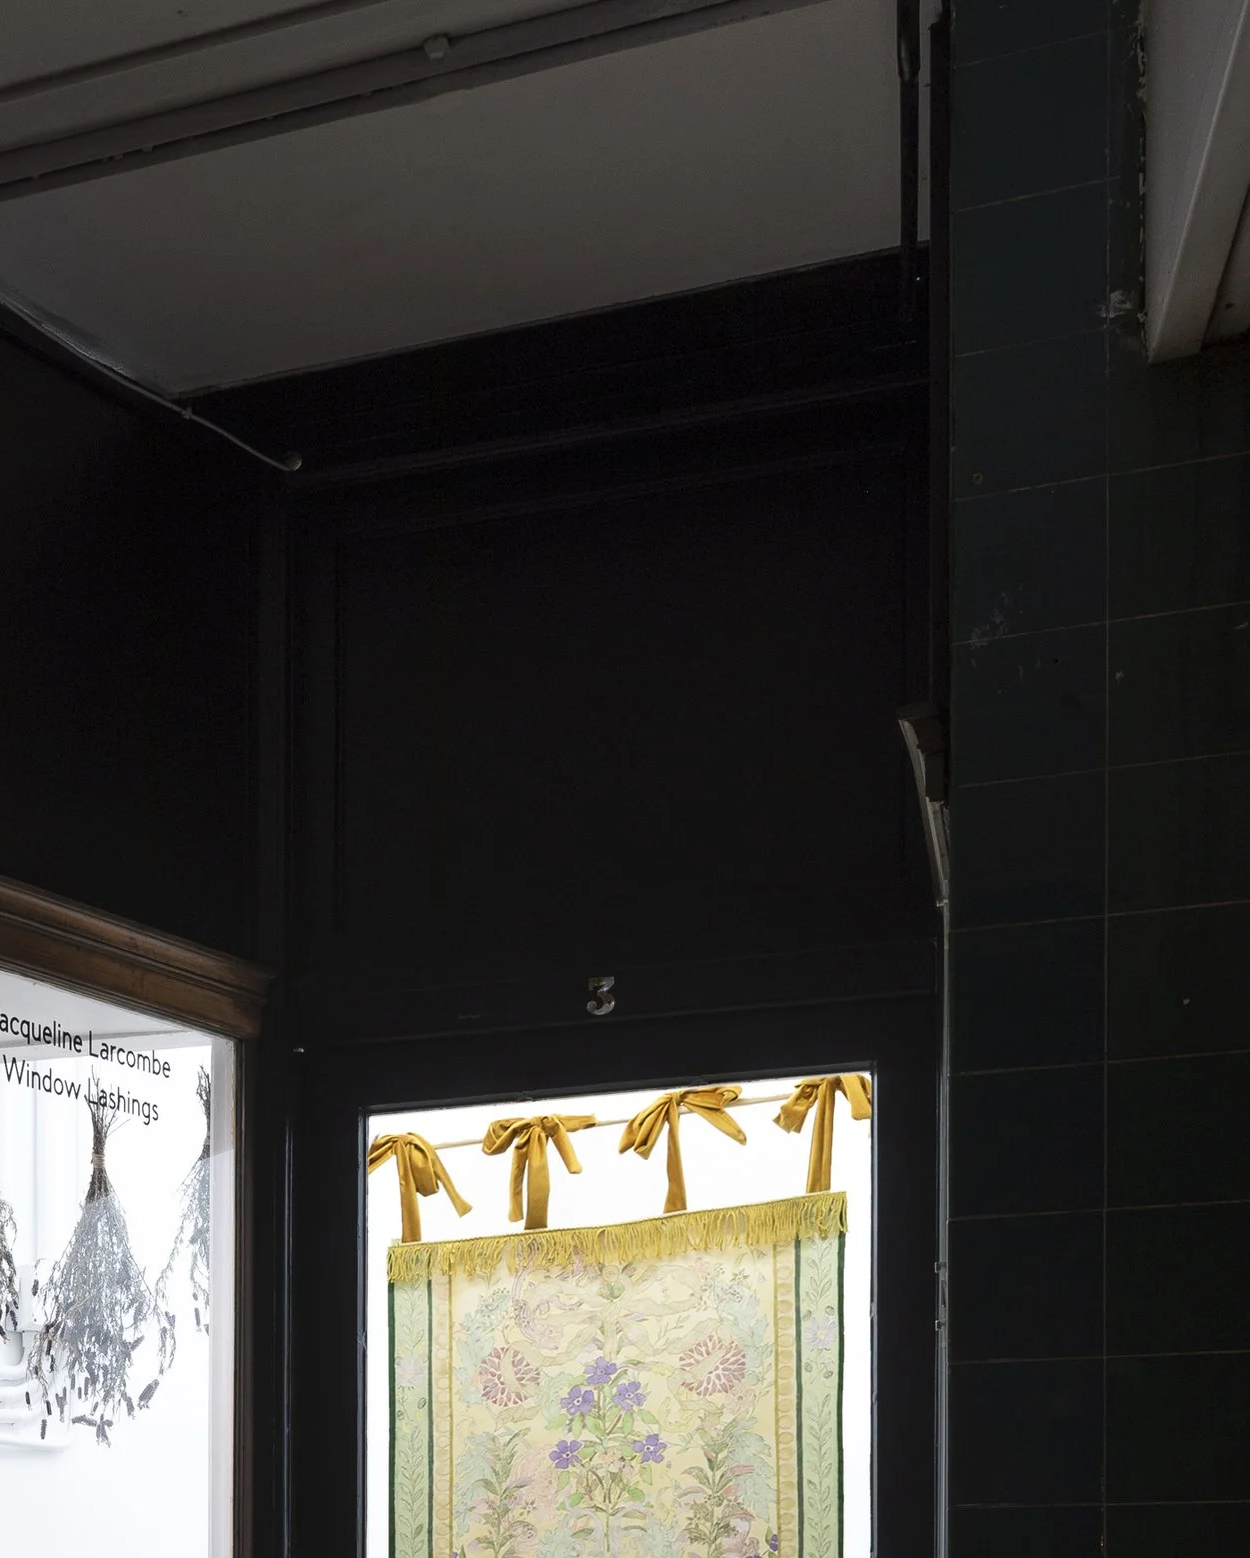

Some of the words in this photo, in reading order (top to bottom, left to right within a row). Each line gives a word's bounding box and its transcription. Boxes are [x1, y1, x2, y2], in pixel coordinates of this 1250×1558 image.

[586, 976, 616, 1016] 3
[88, 1029, 171, 1078] Larcombe
[2, 1053, 82, 1100] Window
[88, 1077, 159, 1126] Lashings
